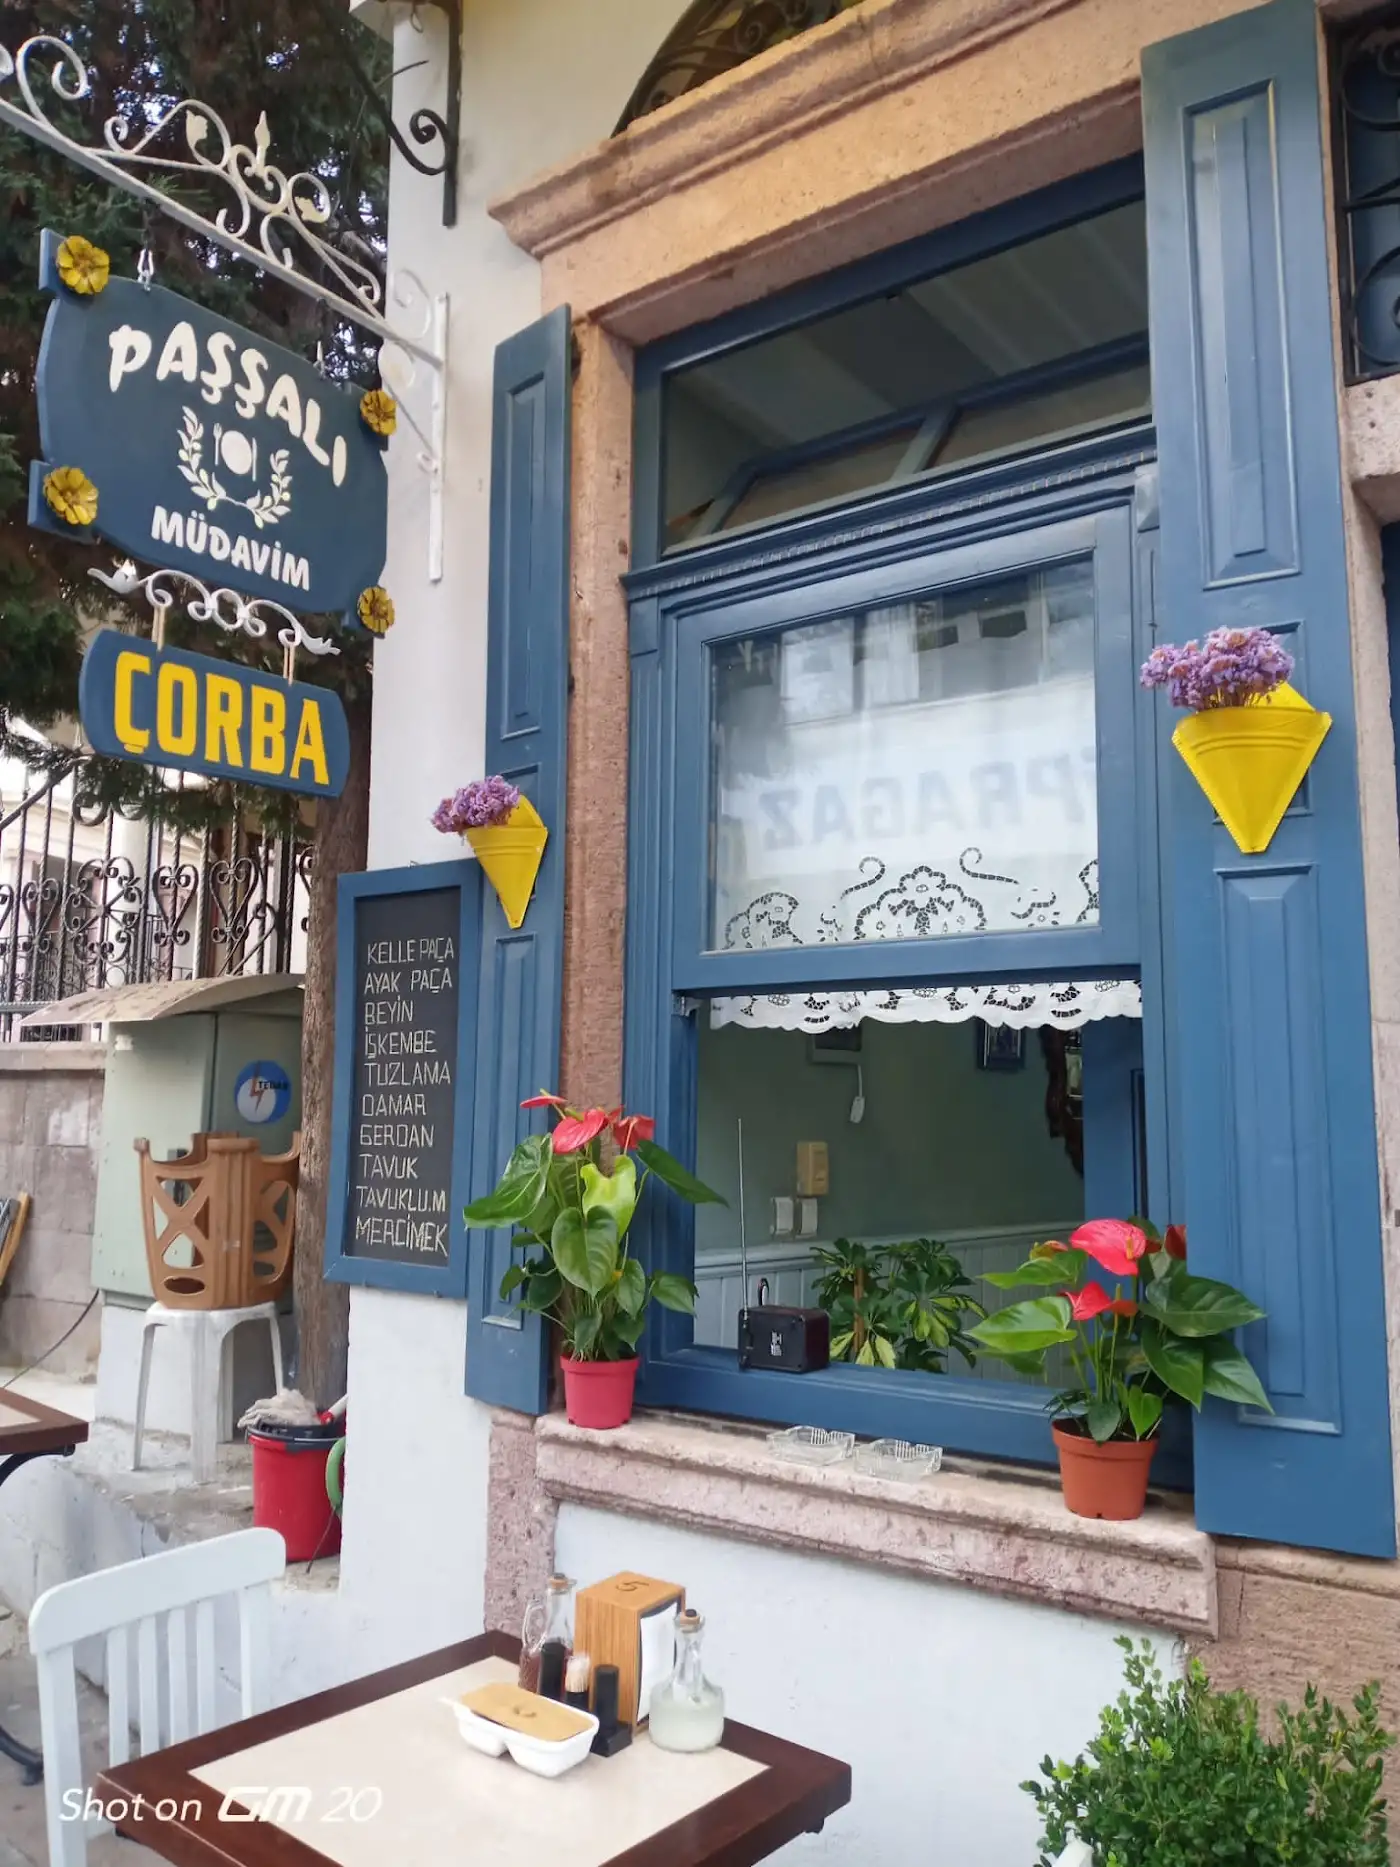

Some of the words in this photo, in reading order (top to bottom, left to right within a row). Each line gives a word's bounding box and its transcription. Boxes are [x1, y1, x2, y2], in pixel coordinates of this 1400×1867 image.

[108, 320, 348, 487] PAŞŞALI
[151, 504, 311, 592] MÜDAVİM
[113, 650, 330, 786] ÇORBA
[367, 939, 417, 965] KELLE
[419, 936, 455, 963] PAÇA
[363, 970, 402, 995] AYAK
[410, 966, 453, 993] PAÇA
[364, 994, 414, 1025] BEYİN
[364, 1025, 438, 1059] İŞKEMBE
[363, 1060, 451, 1088] TUZLAMA
[361, 1093, 427, 1117] DAMAR
[359, 1123, 435, 1149] GERDAN
[358, 1153, 419, 1180] TAVUK
[354, 1213, 449, 1258] MERCİMEK
